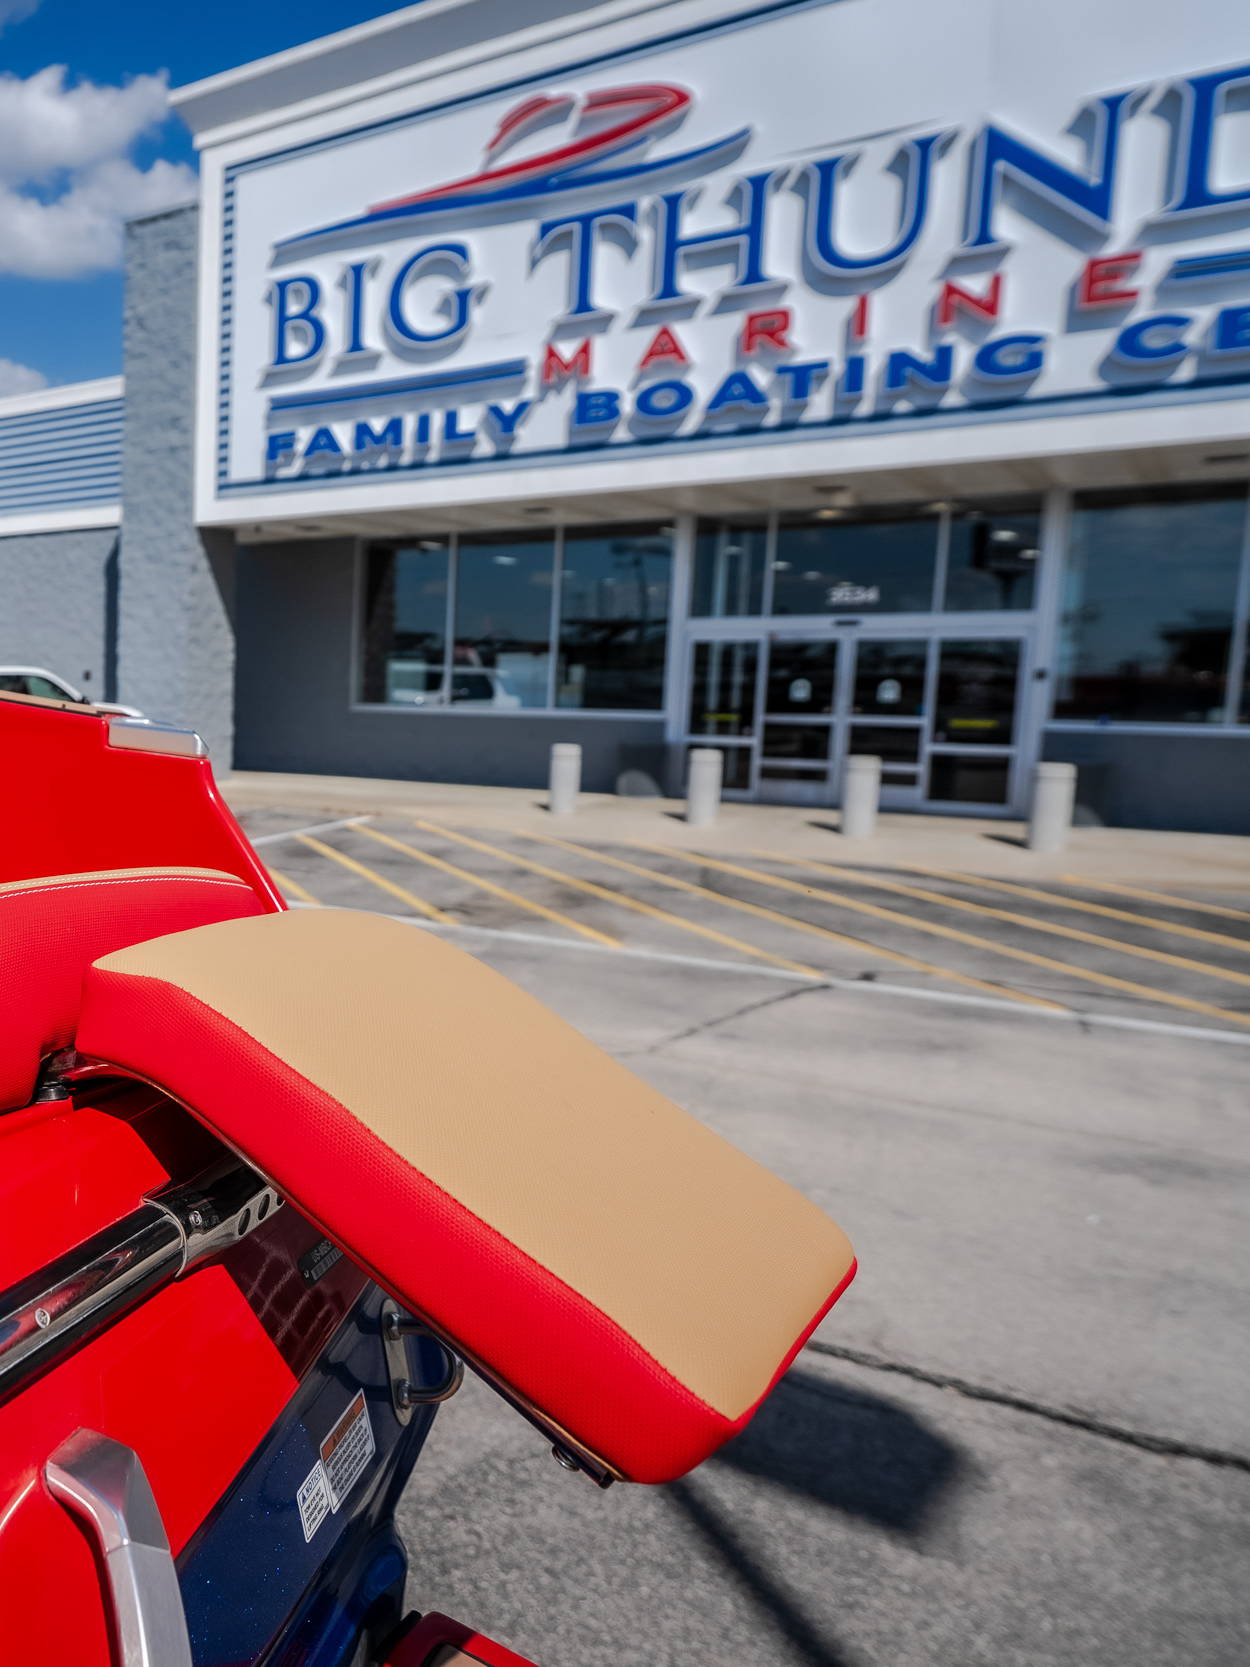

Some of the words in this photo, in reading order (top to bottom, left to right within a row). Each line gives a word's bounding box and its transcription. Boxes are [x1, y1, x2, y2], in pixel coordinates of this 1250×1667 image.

[271, 242, 475, 368] BIG
[542, 250, 1144, 385] MARINE
[266, 400, 533, 463] FAMILY
[574, 334, 1049, 427] BOATING
[305, 1467, 321, 1495] NOTICE
